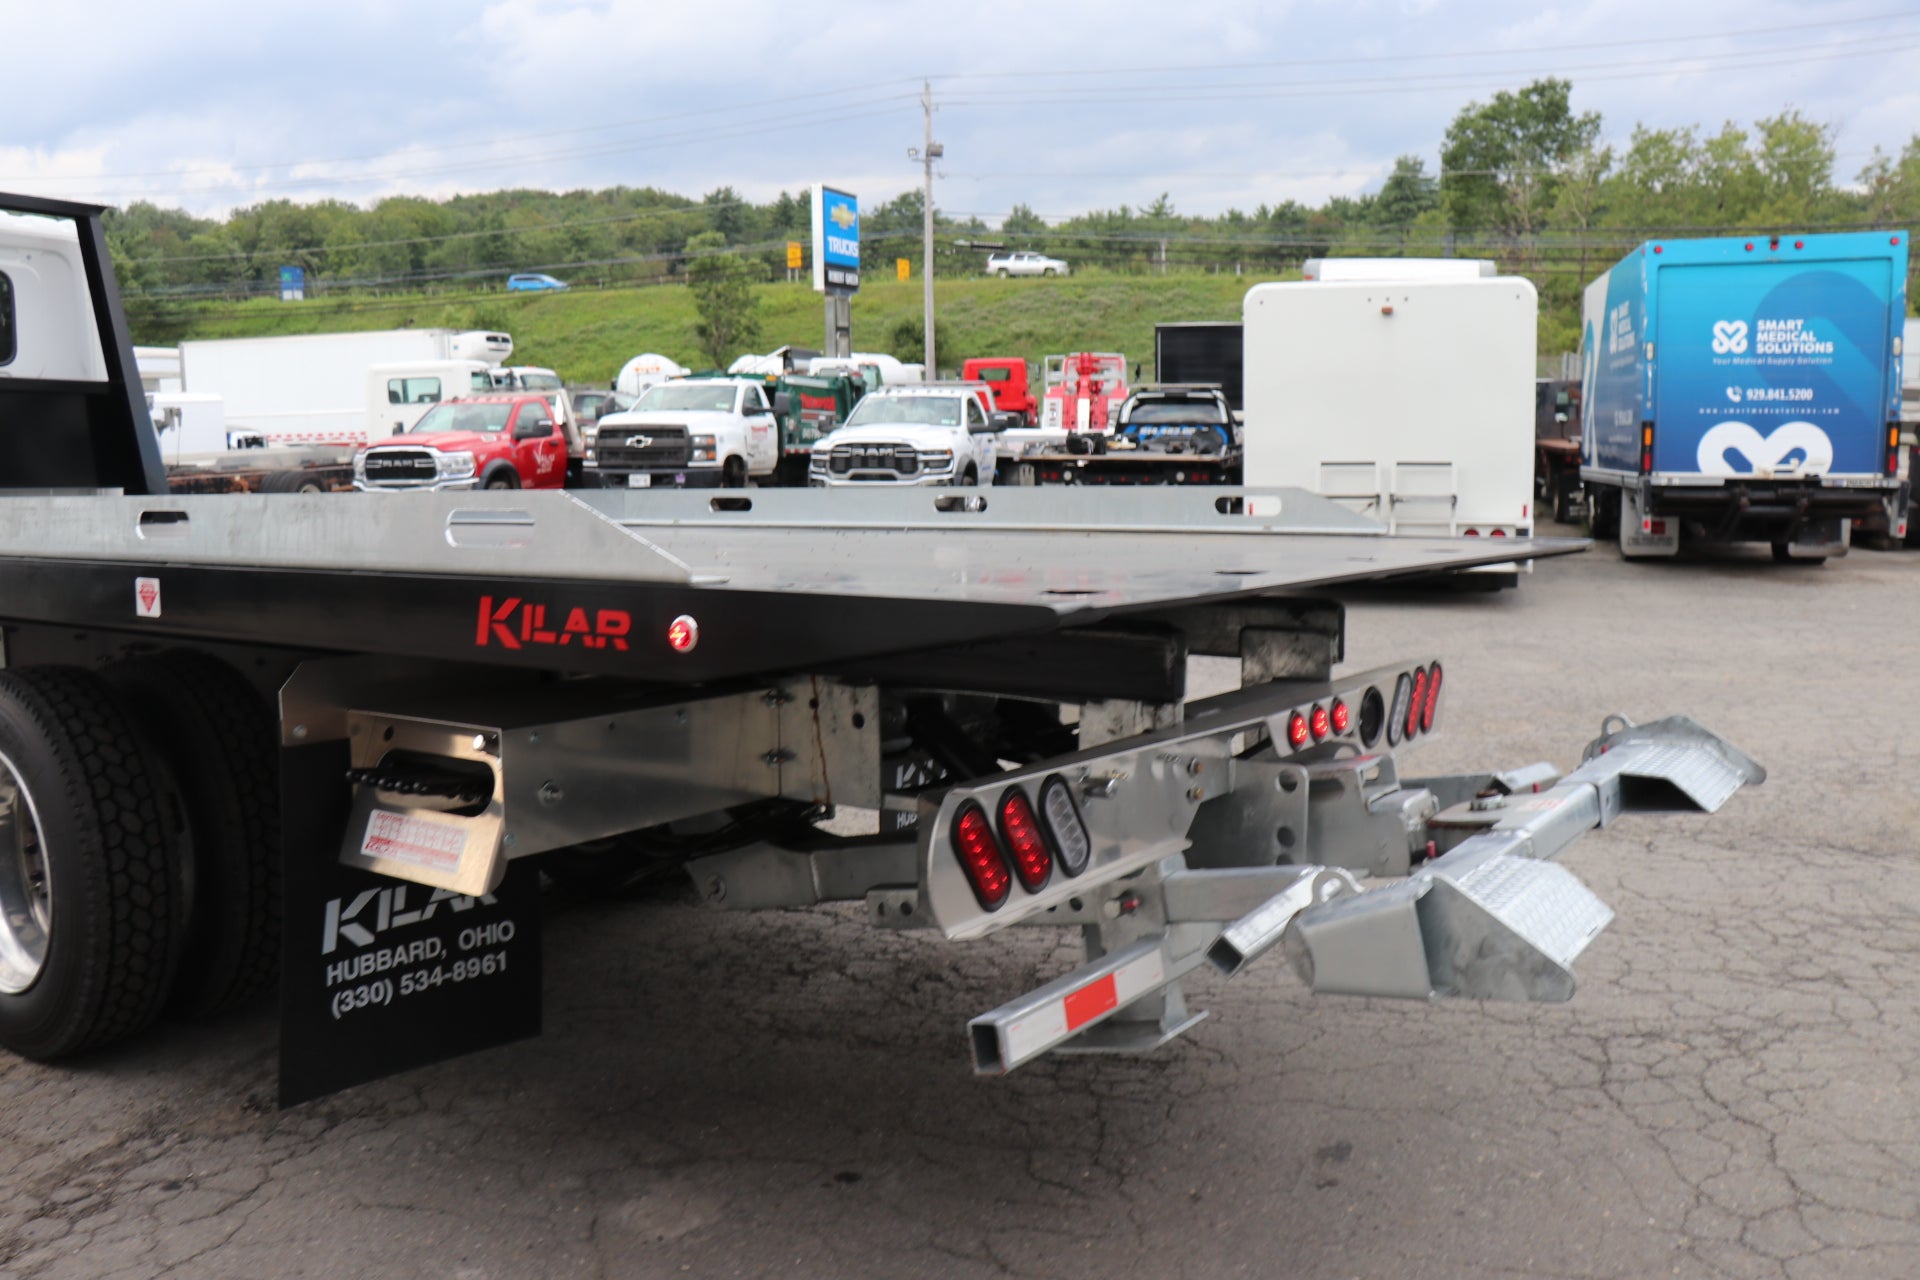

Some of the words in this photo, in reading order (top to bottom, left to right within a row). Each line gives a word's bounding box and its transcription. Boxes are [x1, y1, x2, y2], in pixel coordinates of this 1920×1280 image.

[827, 235, 859, 258] TRUCKS
[1757, 319, 1804, 331] SMART
[1757, 331, 1816, 343] MEDICAL
[1756, 342, 1834, 354] SOLUTIONS
[1712, 357, 1731, 365] Your
[1733, 357, 1765, 365] Medical
[1767, 357, 1795, 366] Supply
[852, 447, 894, 457] RAM
[382, 459, 413, 468] RAM
[475, 595, 632, 650] KILAR
[326, 937, 447, 987] HUBBARD,
[458, 920, 515, 951] OHIO
[331, 979, 394, 1020] (330)
[400, 951, 507, 996] 534-8961
